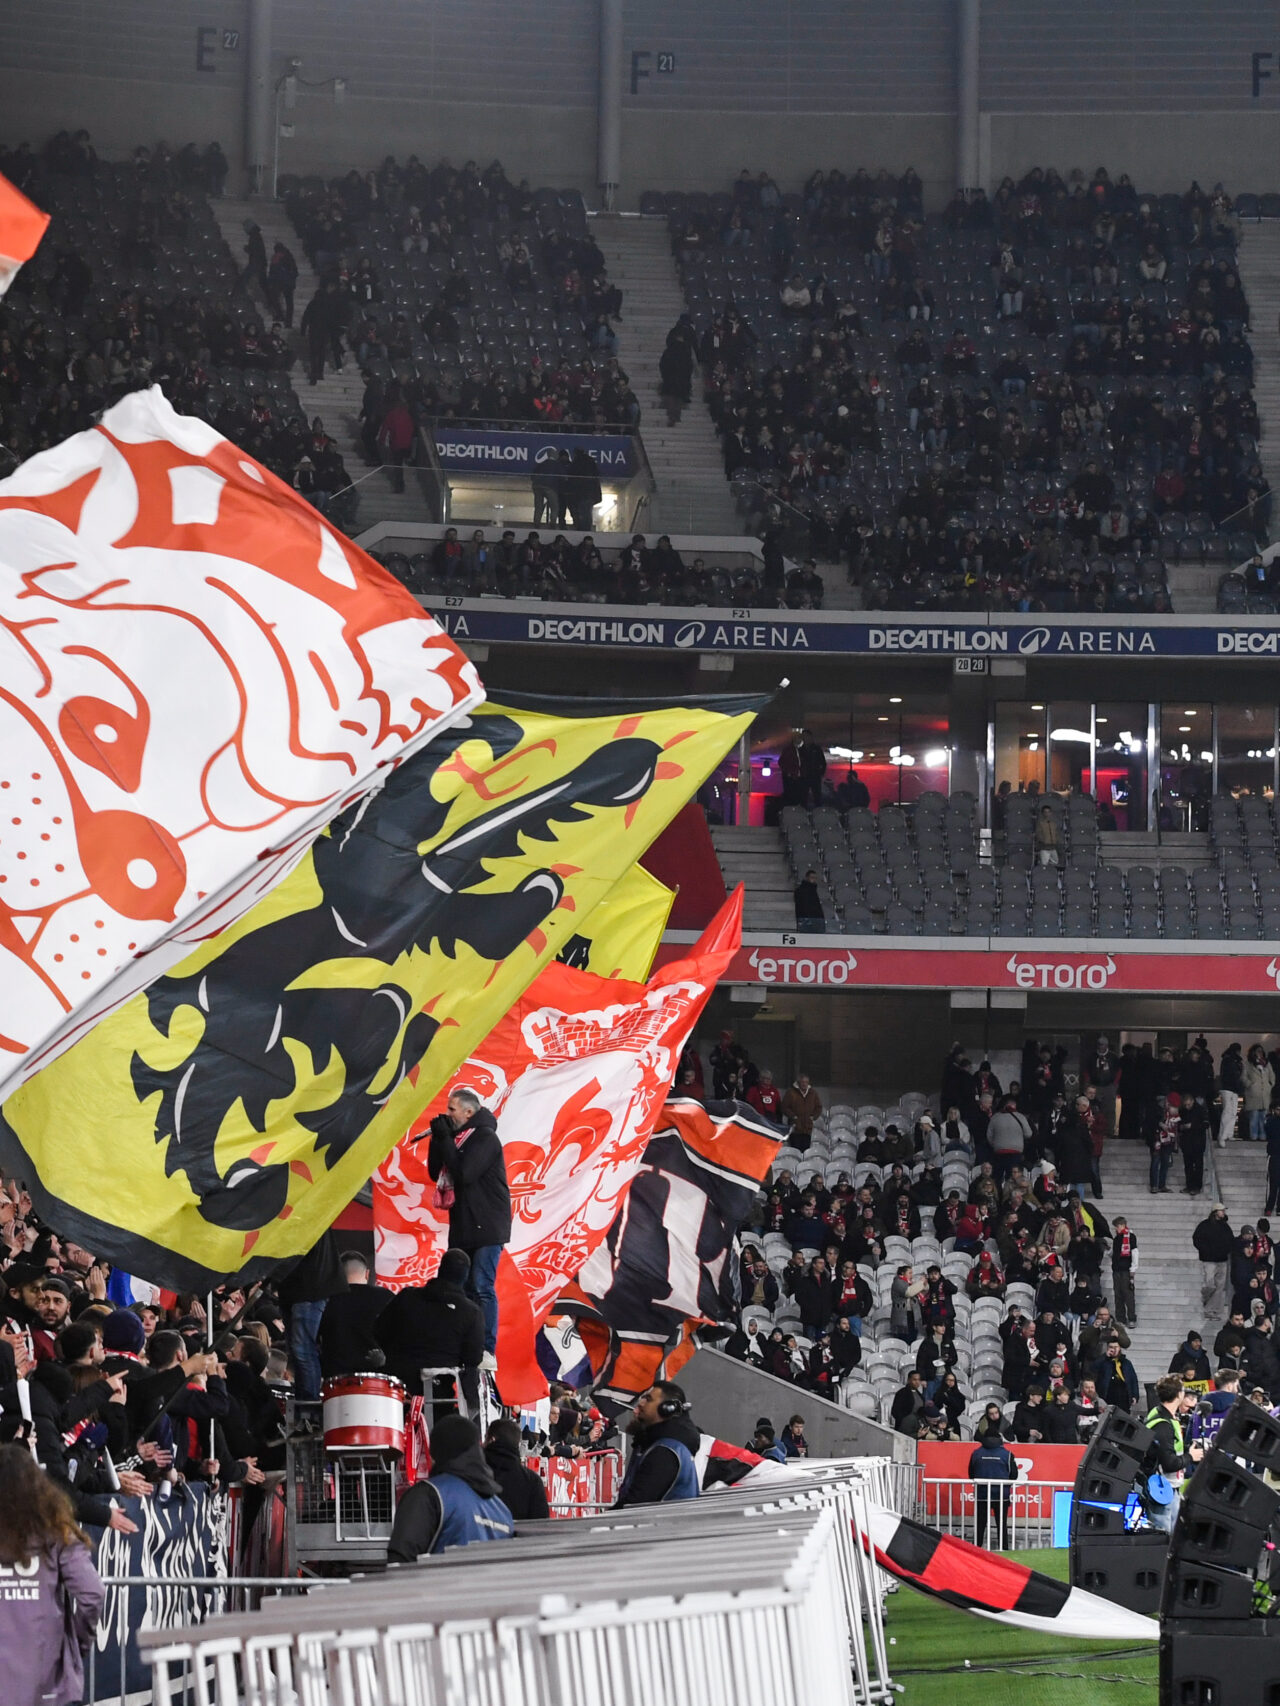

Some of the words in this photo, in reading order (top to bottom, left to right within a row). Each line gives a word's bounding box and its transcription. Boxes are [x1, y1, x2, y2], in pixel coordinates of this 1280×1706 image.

[660, 55, 674, 71] 21
[436, 443, 528, 461] DECATHLON
[445, 596, 464, 607] E27
[732, 609, 751, 619] F21
[528, 619, 664, 644] DECATHLON
[712, 626, 809, 648] ARENA
[868, 629, 1008, 651] DECATHLON
[1057, 631, 1156, 653] ARENA
[782, 934, 797, 946] Fa
[4, 1588, 40, 1601] LILLE
